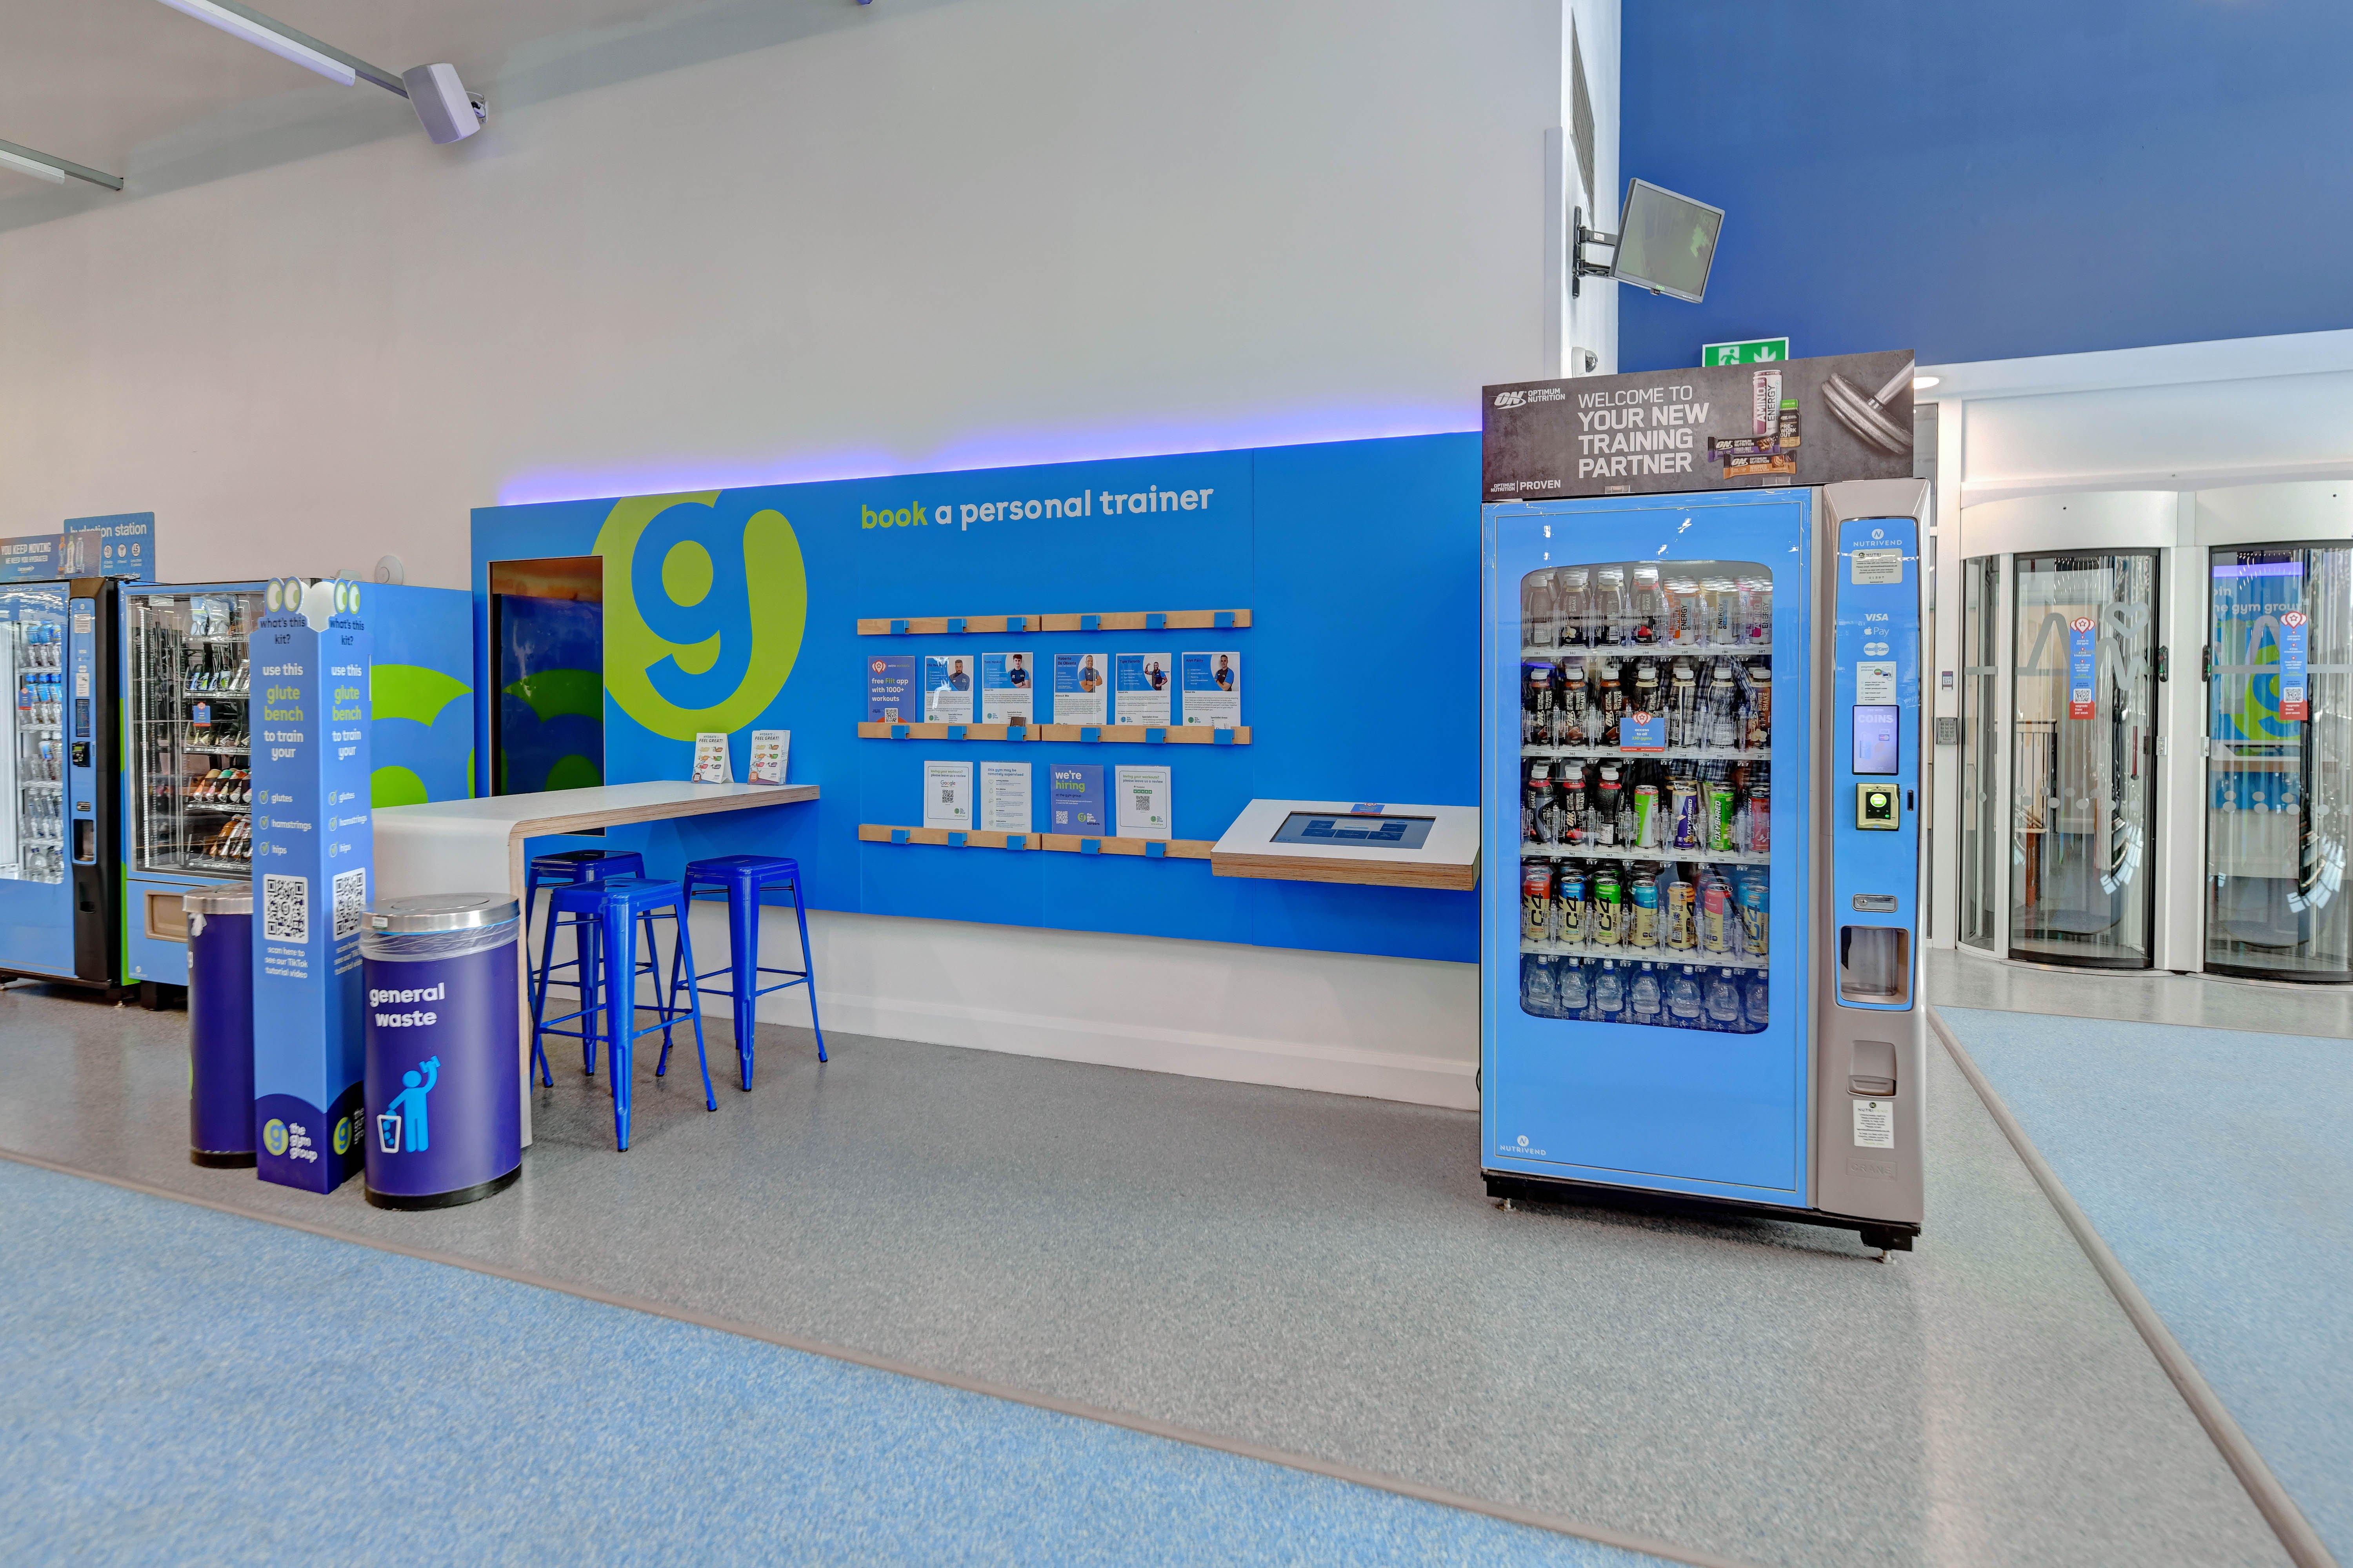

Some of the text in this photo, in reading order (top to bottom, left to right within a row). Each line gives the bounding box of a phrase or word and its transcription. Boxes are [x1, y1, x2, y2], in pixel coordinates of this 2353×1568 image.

[1494, 388, 1560, 409] ON OPTIMUM
[1528, 393, 1566, 403] NUTRITION
[1578, 385, 1692, 408] WELCOME TO
[1577, 402, 1709, 431] YOUR NEW
[1578, 428, 1693, 454] TRAINING
[1716, 441, 1733, 450] ON
[1579, 452, 1692, 478] PARTNER
[1731, 458, 1748, 467] ON
[1520, 480, 1561, 490] PROVEN
[862, 484, 1214, 531] book a personal trainer
[115, 522, 147, 536] station
[13, 544, 27, 554] KEEP
[29, 542, 51, 553] MOVING
[2232, 603, 2260, 614] gym
[260, 617, 306, 628] what's this
[1864, 613, 1889, 621] VISA
[330, 619, 364, 630] what's this
[1873, 627, 1889, 637] Pay
[275, 634, 291, 644] kit?
[341, 635, 353, 645] kit?
[262, 663, 303, 676] use this
[331, 664, 362, 676] use this
[267, 685, 300, 704] glute
[334, 685, 359, 704] glute
[264, 706, 303, 721] bench
[333, 705, 361, 721] bench
[1858, 714, 1893, 723] COINS
[264, 730, 304, 742] to train
[332, 728, 361, 742] to train
[271, 748, 296, 761] your
[338, 746, 356, 760] your
[1055, 770, 1082, 779] we're
[1056, 780, 1085, 792] hiring
[271, 794, 293, 803] glutes
[271, 819, 312, 831] hamstrings
[272, 845, 287, 856] hips
[1531, 893, 1543, 927] C4
[1566, 895, 1578, 929] C4
[1599, 896, 1612, 931] C4
[1747, 905, 1760, 940] C4
[284, 947, 297, 956] here
[288, 958, 308, 968] TikTok
[265, 967, 307, 978] tutorial video
[369, 982, 445, 1007] general
[375, 1010, 437, 1027] waste
[289, 1123, 306, 1136] the
[289, 1135, 311, 1148] gym
[289, 1147, 318, 1163] group
[1500, 1145, 1546, 1156] NUTRIVEND
